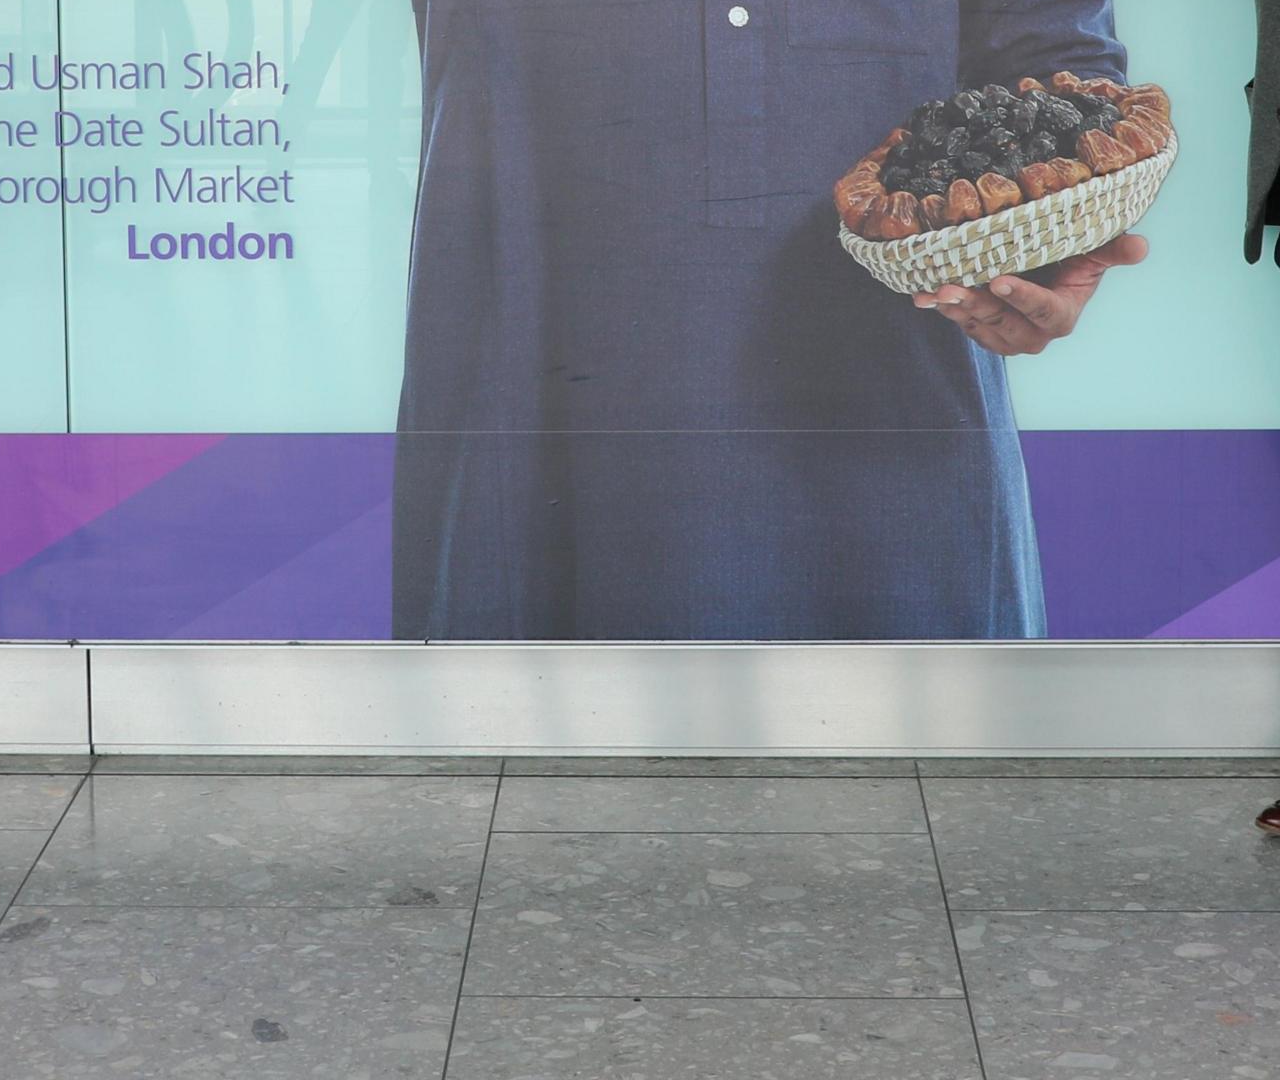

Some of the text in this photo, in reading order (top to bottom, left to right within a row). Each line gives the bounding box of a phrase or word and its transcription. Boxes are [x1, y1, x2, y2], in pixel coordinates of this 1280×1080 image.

[32, 53, 166, 91] Usman
[183, 51, 291, 95] Shah,
[54, 111, 145, 148] Date
[159, 108, 291, 152] Sultan,
[155, 165, 295, 204] Market
[127, 222, 295, 260] London
